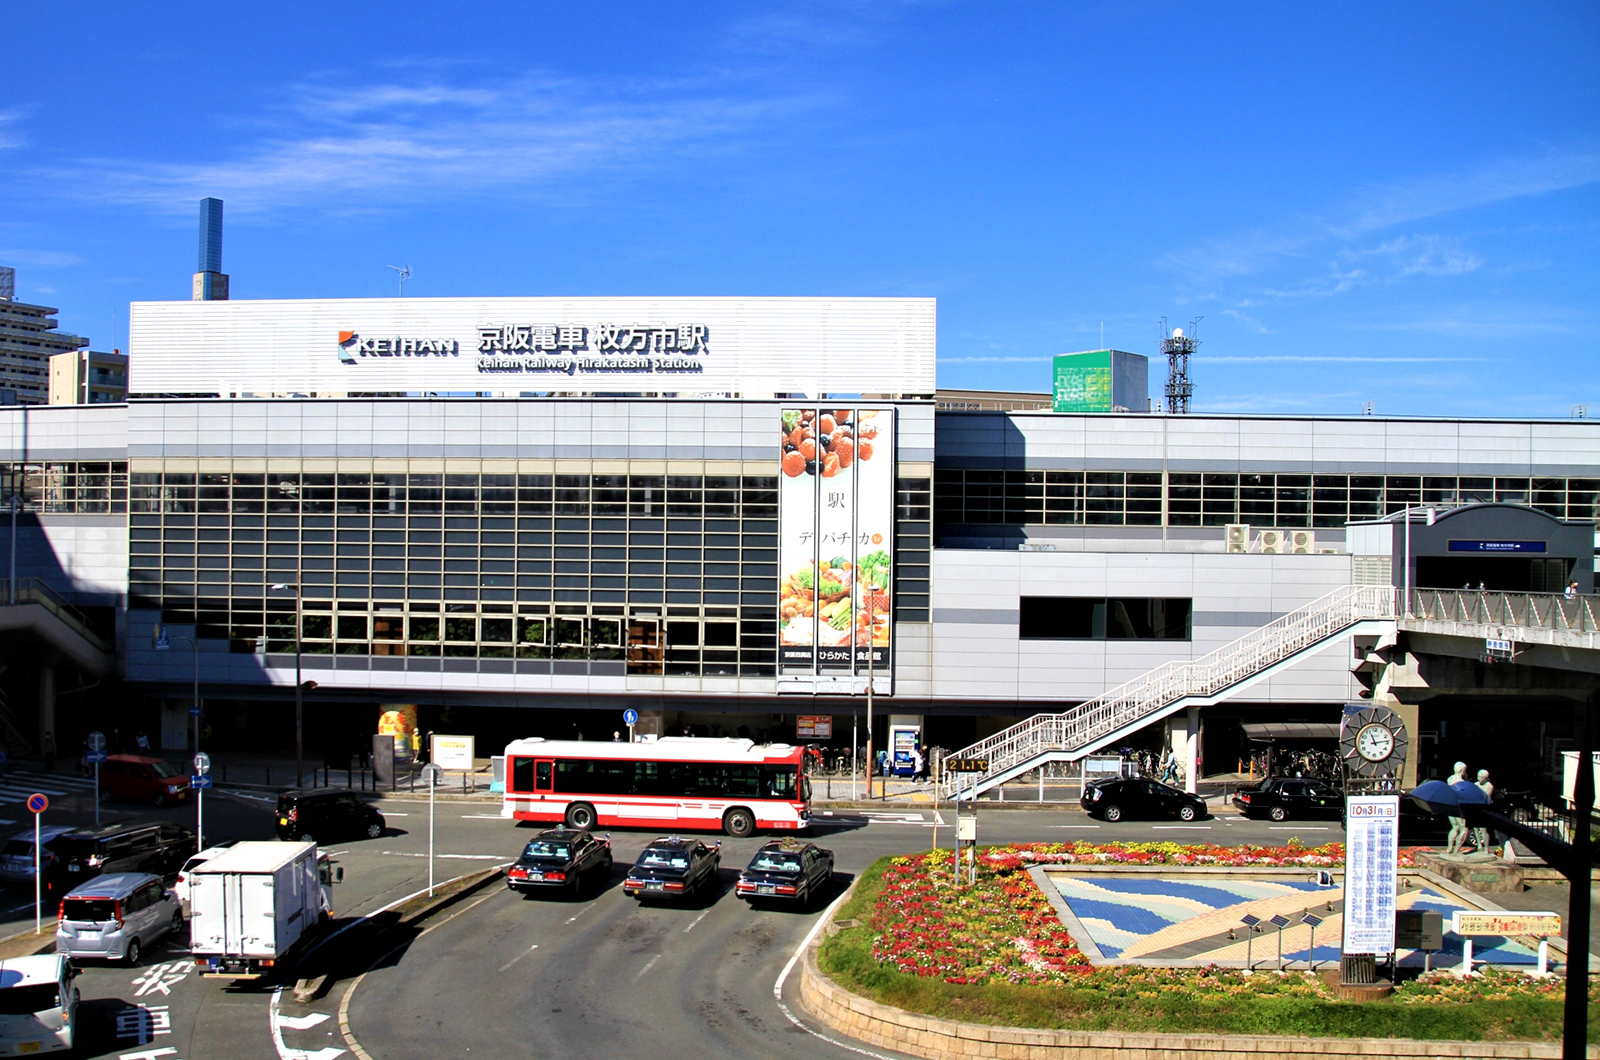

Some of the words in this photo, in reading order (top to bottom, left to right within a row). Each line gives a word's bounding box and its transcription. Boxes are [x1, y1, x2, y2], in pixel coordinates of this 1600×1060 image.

[356, 334, 457, 354] KEIHAN
[476, 322, 585, 352] 京阪電車
[593, 322, 706, 352] 枚方市駅
[475, 356, 519, 369] Keihan
[522, 356, 573, 372] Railway
[576, 356, 649, 370] Hirakatashi
[652, 356, 700, 370] Station
[828, 492, 845, 508] 駅
[799, 532, 870, 546] デパチカ
[819, 651, 850, 660] ひらかた
